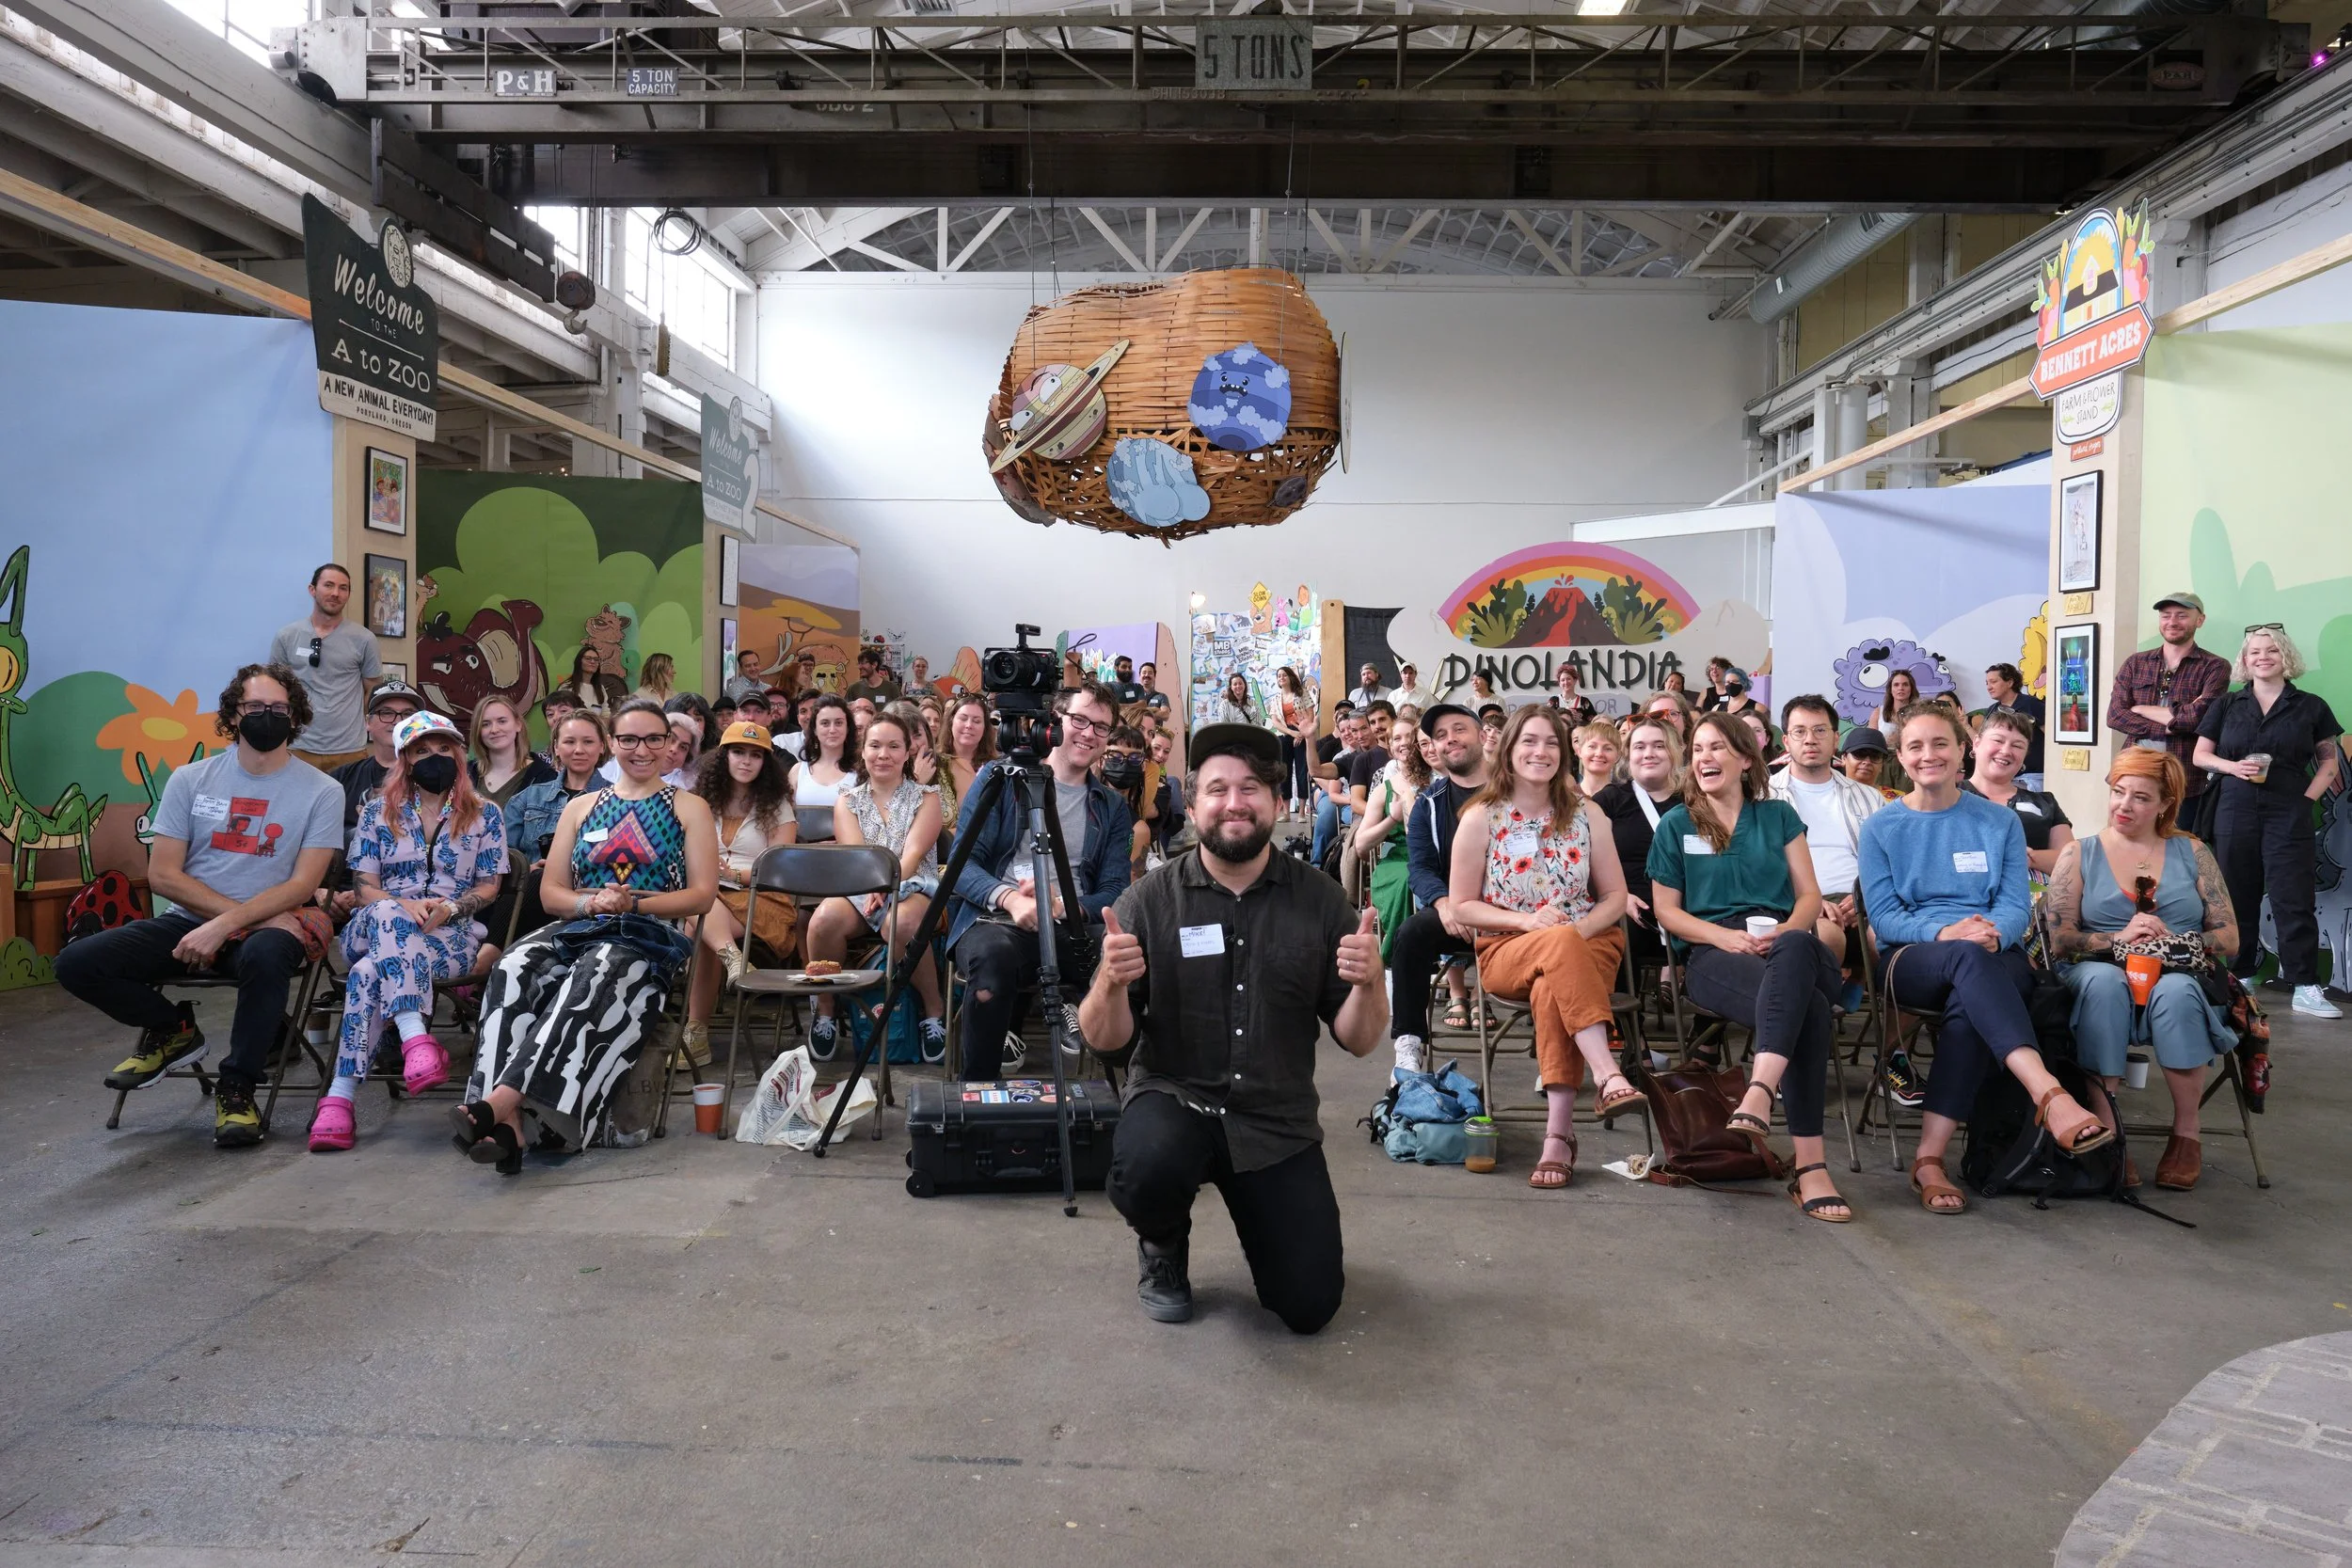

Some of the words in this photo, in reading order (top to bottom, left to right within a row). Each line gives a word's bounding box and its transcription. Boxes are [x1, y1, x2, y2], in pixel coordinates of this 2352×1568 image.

[1204, 35, 1218, 79] 5
[1232, 34, 1304, 80] TONS
[628, 83, 676, 94] CAPACITY
[632, 70, 641, 83] 5
[647, 70, 674, 83] TON
[334, 253, 424, 336] Welcome
[371, 318, 380, 332] TO
[384, 325, 397, 339] THE
[331, 338, 353, 364] A
[359, 348, 381, 374] to
[388, 357, 431, 393] ZOO
[2040, 339, 2098, 384] BENNETT
[2098, 320, 2141, 359] ACRES
[324, 376, 332, 393] A
[334, 378, 356, 399] NEW
[358, 388, 390, 411] ANIMAL
[392, 398, 434, 425] EVERYDAY!
[2061, 394, 2082, 413] FARM
[2088, 382, 2115, 404] FLOWER
[2076, 405, 2099, 424] STAND
[708, 426, 743, 466] Welcome
[707, 474, 715, 490] A
[716, 479, 724, 494] to
[725, 481, 742, 501] ZOO
[1214, 641, 1231, 650] MB
